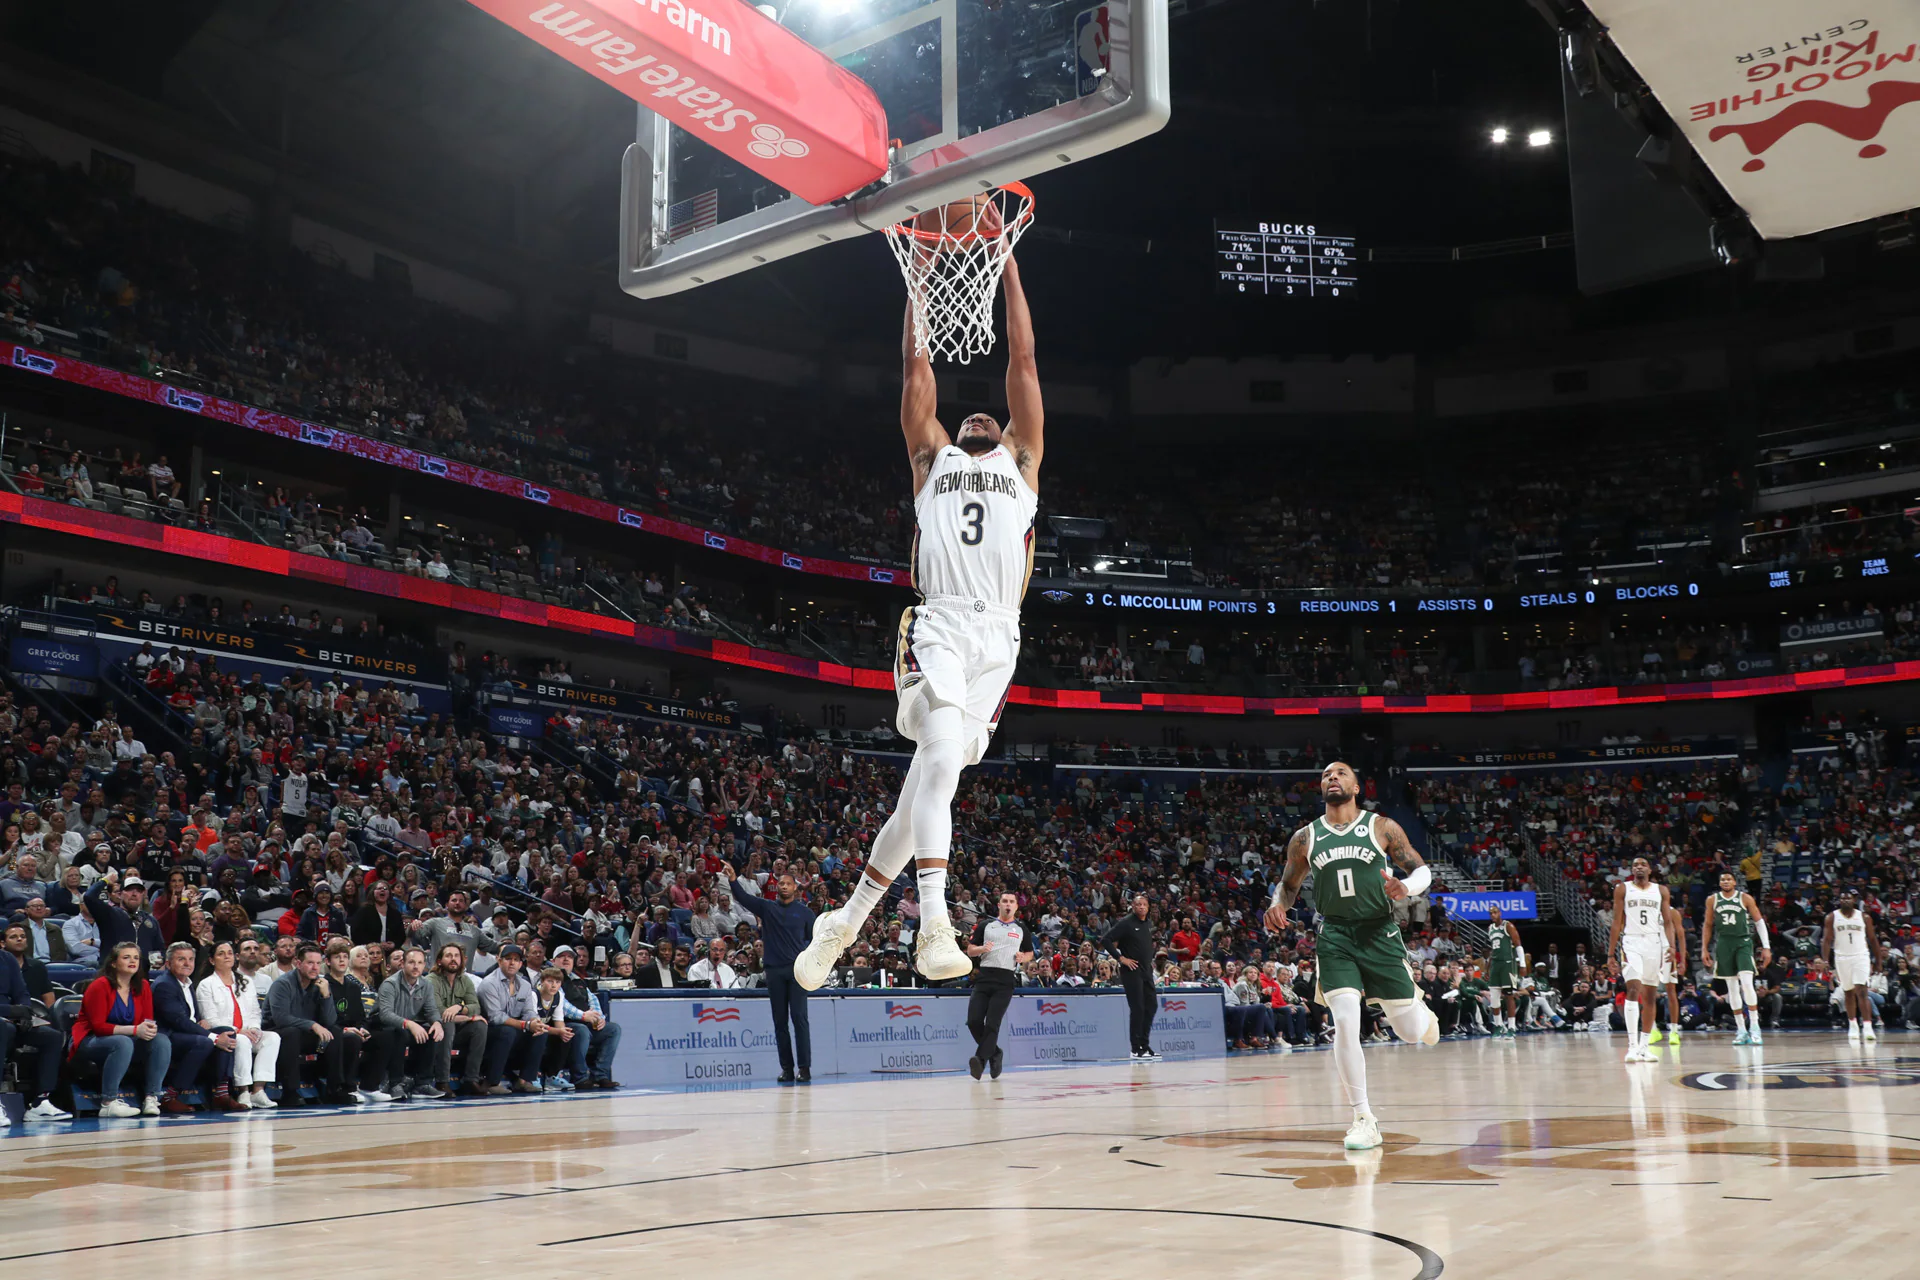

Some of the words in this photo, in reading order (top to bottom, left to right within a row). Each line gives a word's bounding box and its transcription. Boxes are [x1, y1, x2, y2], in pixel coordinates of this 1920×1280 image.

[1736, 19, 1869, 64] CENTER
[1689, 43, 1920, 122] MOOTHIE
[1259, 222, 1317, 236] BUCKS
[1231, 242, 1253, 253] 71%
[1280, 245, 1297, 255] 0%
[1323, 247, 1346, 258] 67%
[1236, 262, 1244, 272] 0
[1285, 264, 1292, 274] 4
[1331, 267, 1338, 277] 4
[1238, 283, 1245, 293] 6
[1287, 285, 1293, 295] 3
[1332, 287, 1339, 297] 0
[932, 470, 964, 499] NEW
[963, 471, 1017, 500] ORLEANS
[960, 502, 985, 547] 3
[1862, 558, 1886, 568] TEAM
[1769, 570, 1789, 580] TIME
[1796, 570, 1806, 583] 7
[1833, 565, 1843, 578] 2
[1861, 566, 1889, 577] FOULS
[1769, 578, 1791, 588] OUTS
[1085, 592, 1095, 606] 3
[1102, 593, 1117, 607] C.
[1120, 594, 1203, 612] MCCOLLUM
[1208, 600, 1258, 614] POINTS
[1267, 602, 1276, 615] 3
[1300, 600, 1380, 613] REBOUNDS
[1388, 600, 1397, 613] 1
[1417, 598, 1477, 612] ASSISTS
[1483, 598, 1493, 611] 0
[1520, 592, 1578, 608] STEALS
[1585, 591, 1595, 604] 0
[1615, 584, 1680, 601] BLOCKS
[1688, 583, 1699, 597] 0
[1806, 622, 1836, 635] HUB
[1836, 617, 1876, 632] CLUB
[138, 620, 256, 649] BETRIVERS
[28, 647, 50, 657] GREY
[51, 651, 80, 662] GOOSE
[318, 649, 417, 675] BETRIVERS
[537, 684, 618, 706] BETRIVERS
[661, 704, 732, 725] BETRIVERS
[821, 704, 846, 727] 115
[1474, 751, 1557, 763] BETRIVERS
[1605, 744, 1692, 757] BETRIVERS
[294, 789, 300, 800] 5
[375, 823, 393, 833] NOLA
[1312, 845, 1377, 871] MILWAUKEE
[1336, 868, 1356, 898] 0
[1640, 910, 1648, 925] 5
[1721, 913, 1737, 926] 34
[1848, 932, 1853, 944] 1
[1008, 1021, 1067, 1037] AmeriHealth
[1067, 1019, 1098, 1036] Caritas
[1150, 1017, 1186, 1032] eriHealth
[645, 1030, 737, 1050] AmeriHealth
[849, 1025, 921, 1044] AmeriHealth
[922, 1022, 959, 1042] Caritas
[1033, 1043, 1077, 1059] Louisiana
[1159, 1037, 1196, 1051] Louisiana
[880, 1051, 933, 1068] Louisiana
[684, 1060, 752, 1079] Louisiana
